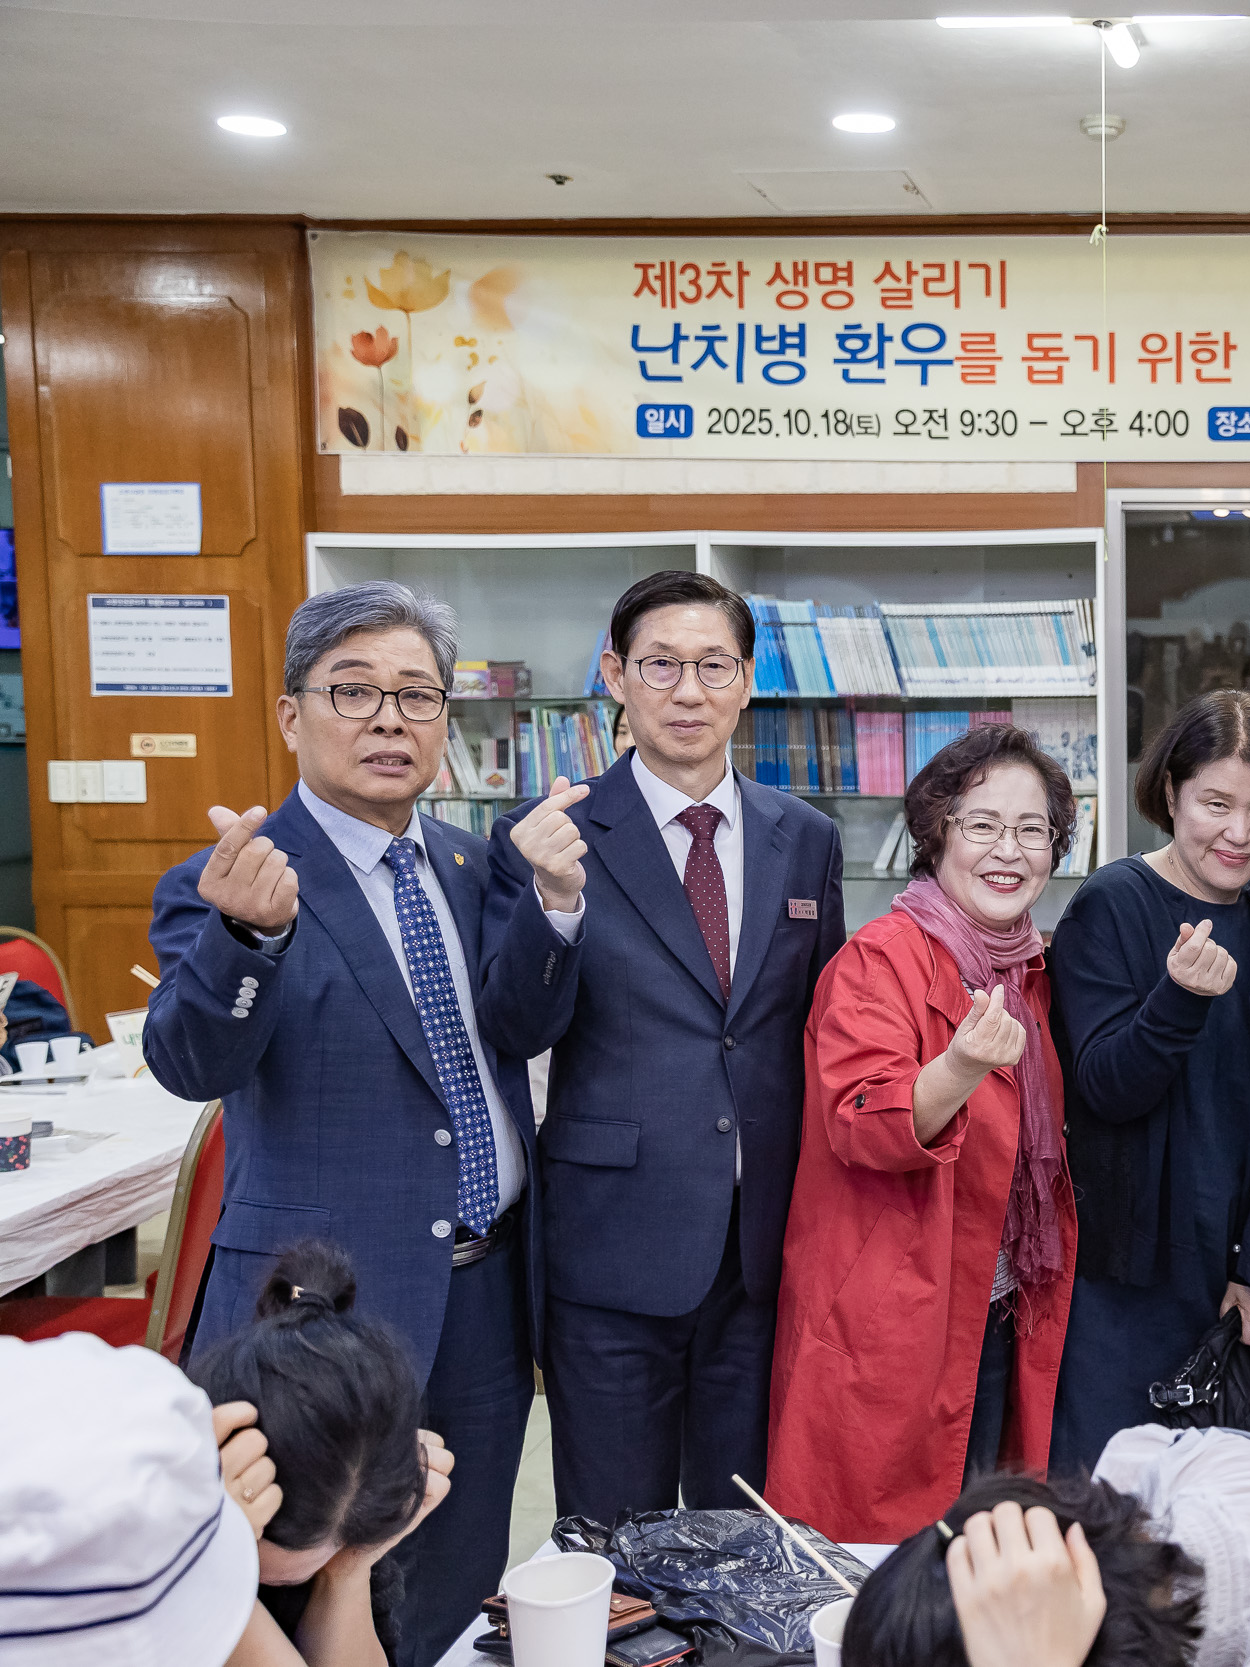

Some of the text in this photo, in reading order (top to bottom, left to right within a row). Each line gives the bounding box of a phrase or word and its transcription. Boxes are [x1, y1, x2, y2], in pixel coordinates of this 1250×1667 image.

[633, 260, 1008, 310] 제3차 생명 살리기
[630, 322, 808, 386] 난치병
[832, 322, 1004, 387] 환우를
[1021, 332, 1117, 385] 돕기
[1137, 331, 1238, 384] 위한
[644, 408, 686, 434] 일시
[707, 408, 881, 438] 2025.10.18(토)
[893, 408, 950, 440] 오전
[960, 409, 1018, 437] 9:30
[1060, 408, 1119, 440] 오후
[1128, 410, 1190, 438] 4:00
